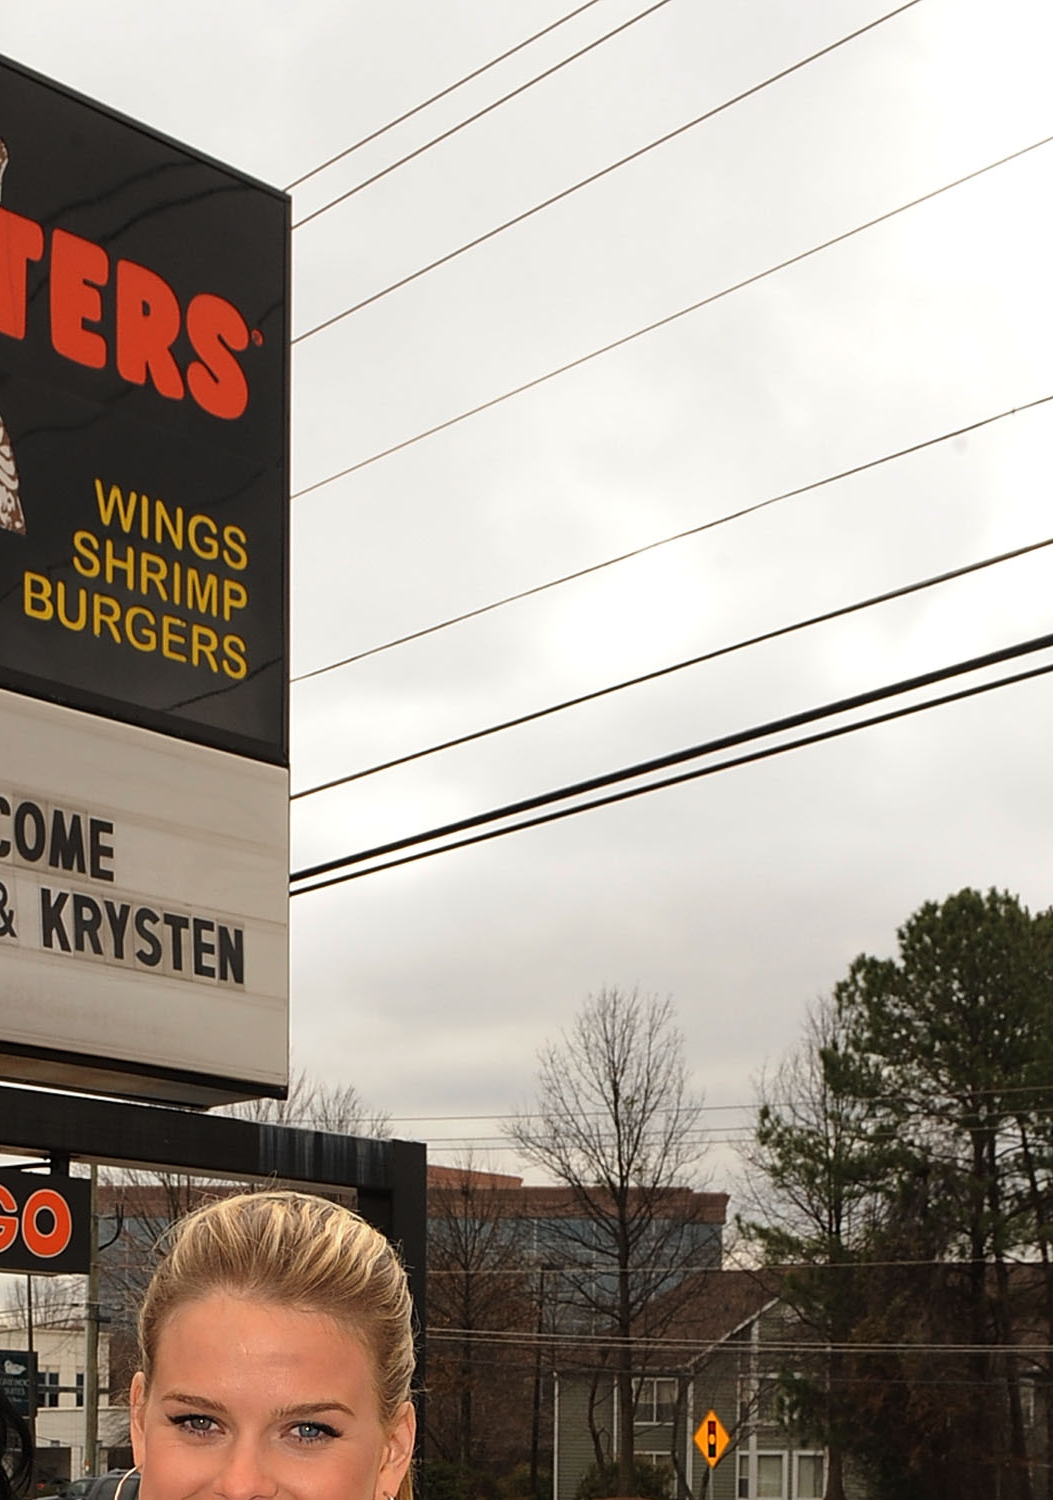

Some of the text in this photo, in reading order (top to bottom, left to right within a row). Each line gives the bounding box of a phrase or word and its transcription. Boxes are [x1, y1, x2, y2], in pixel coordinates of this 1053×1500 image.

[94, 478, 248, 571] WINGS
[72, 530, 248, 621] SHRIMP
[24, 571, 247, 680] BURGERS
[40, 887, 244, 985] KRYSTEN
